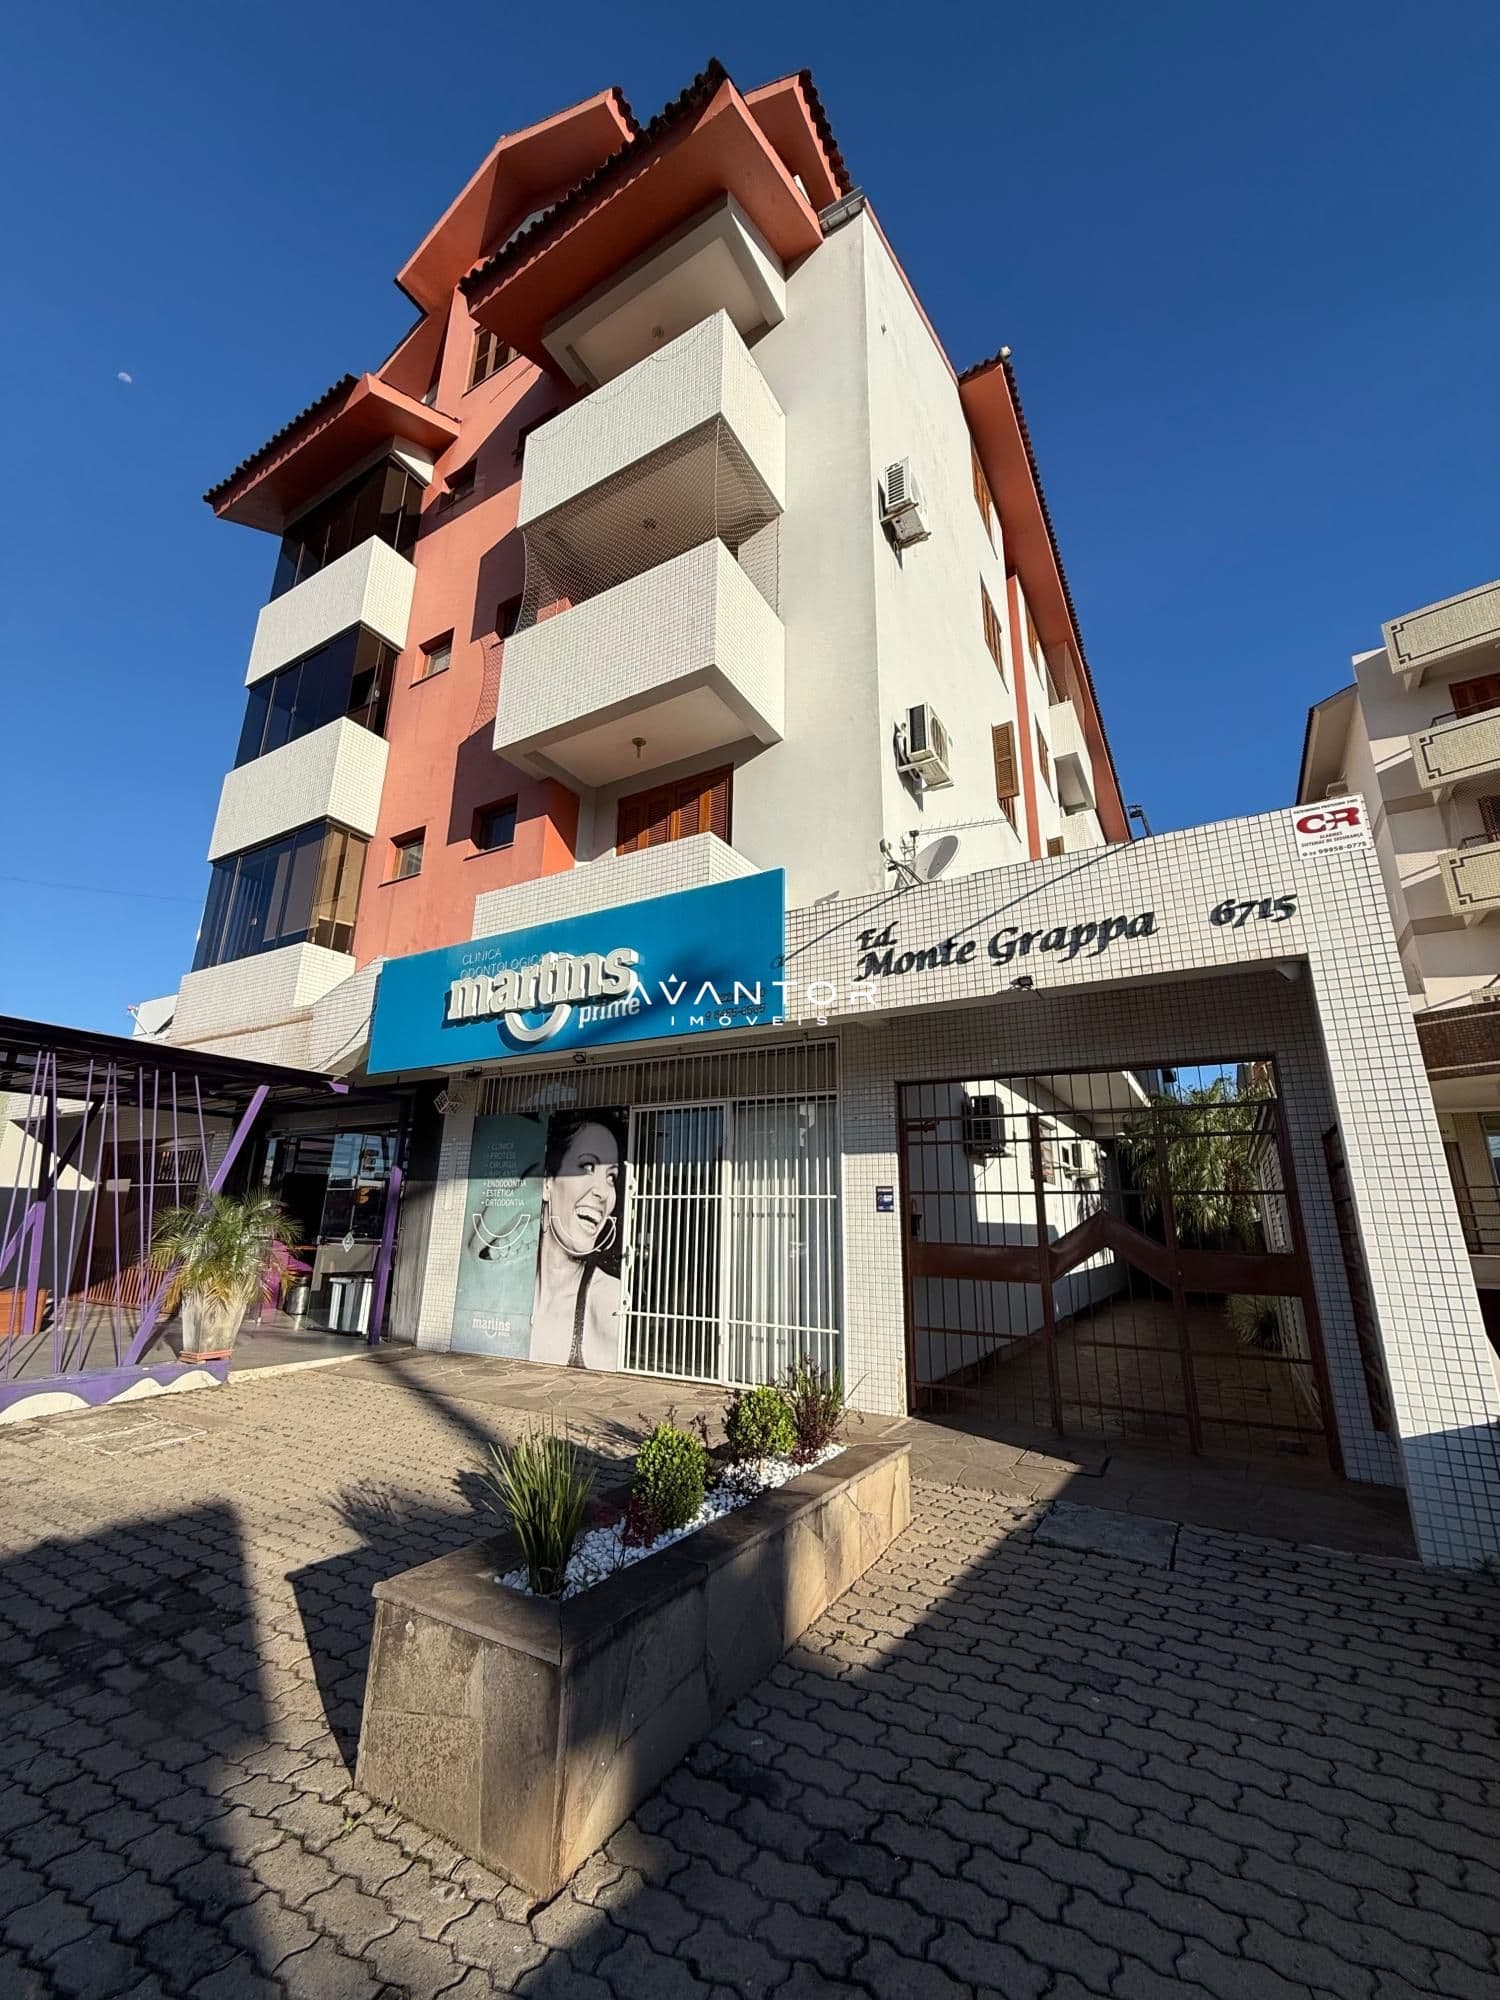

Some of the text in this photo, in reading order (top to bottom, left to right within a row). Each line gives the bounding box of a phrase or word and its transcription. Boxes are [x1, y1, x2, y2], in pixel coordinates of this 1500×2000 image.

[1210, 894, 1298, 929] 6715
[854, 911, 1161, 982] Monte Grappa
[447, 947, 640, 1021] martins
[578, 997, 641, 1029] prime
